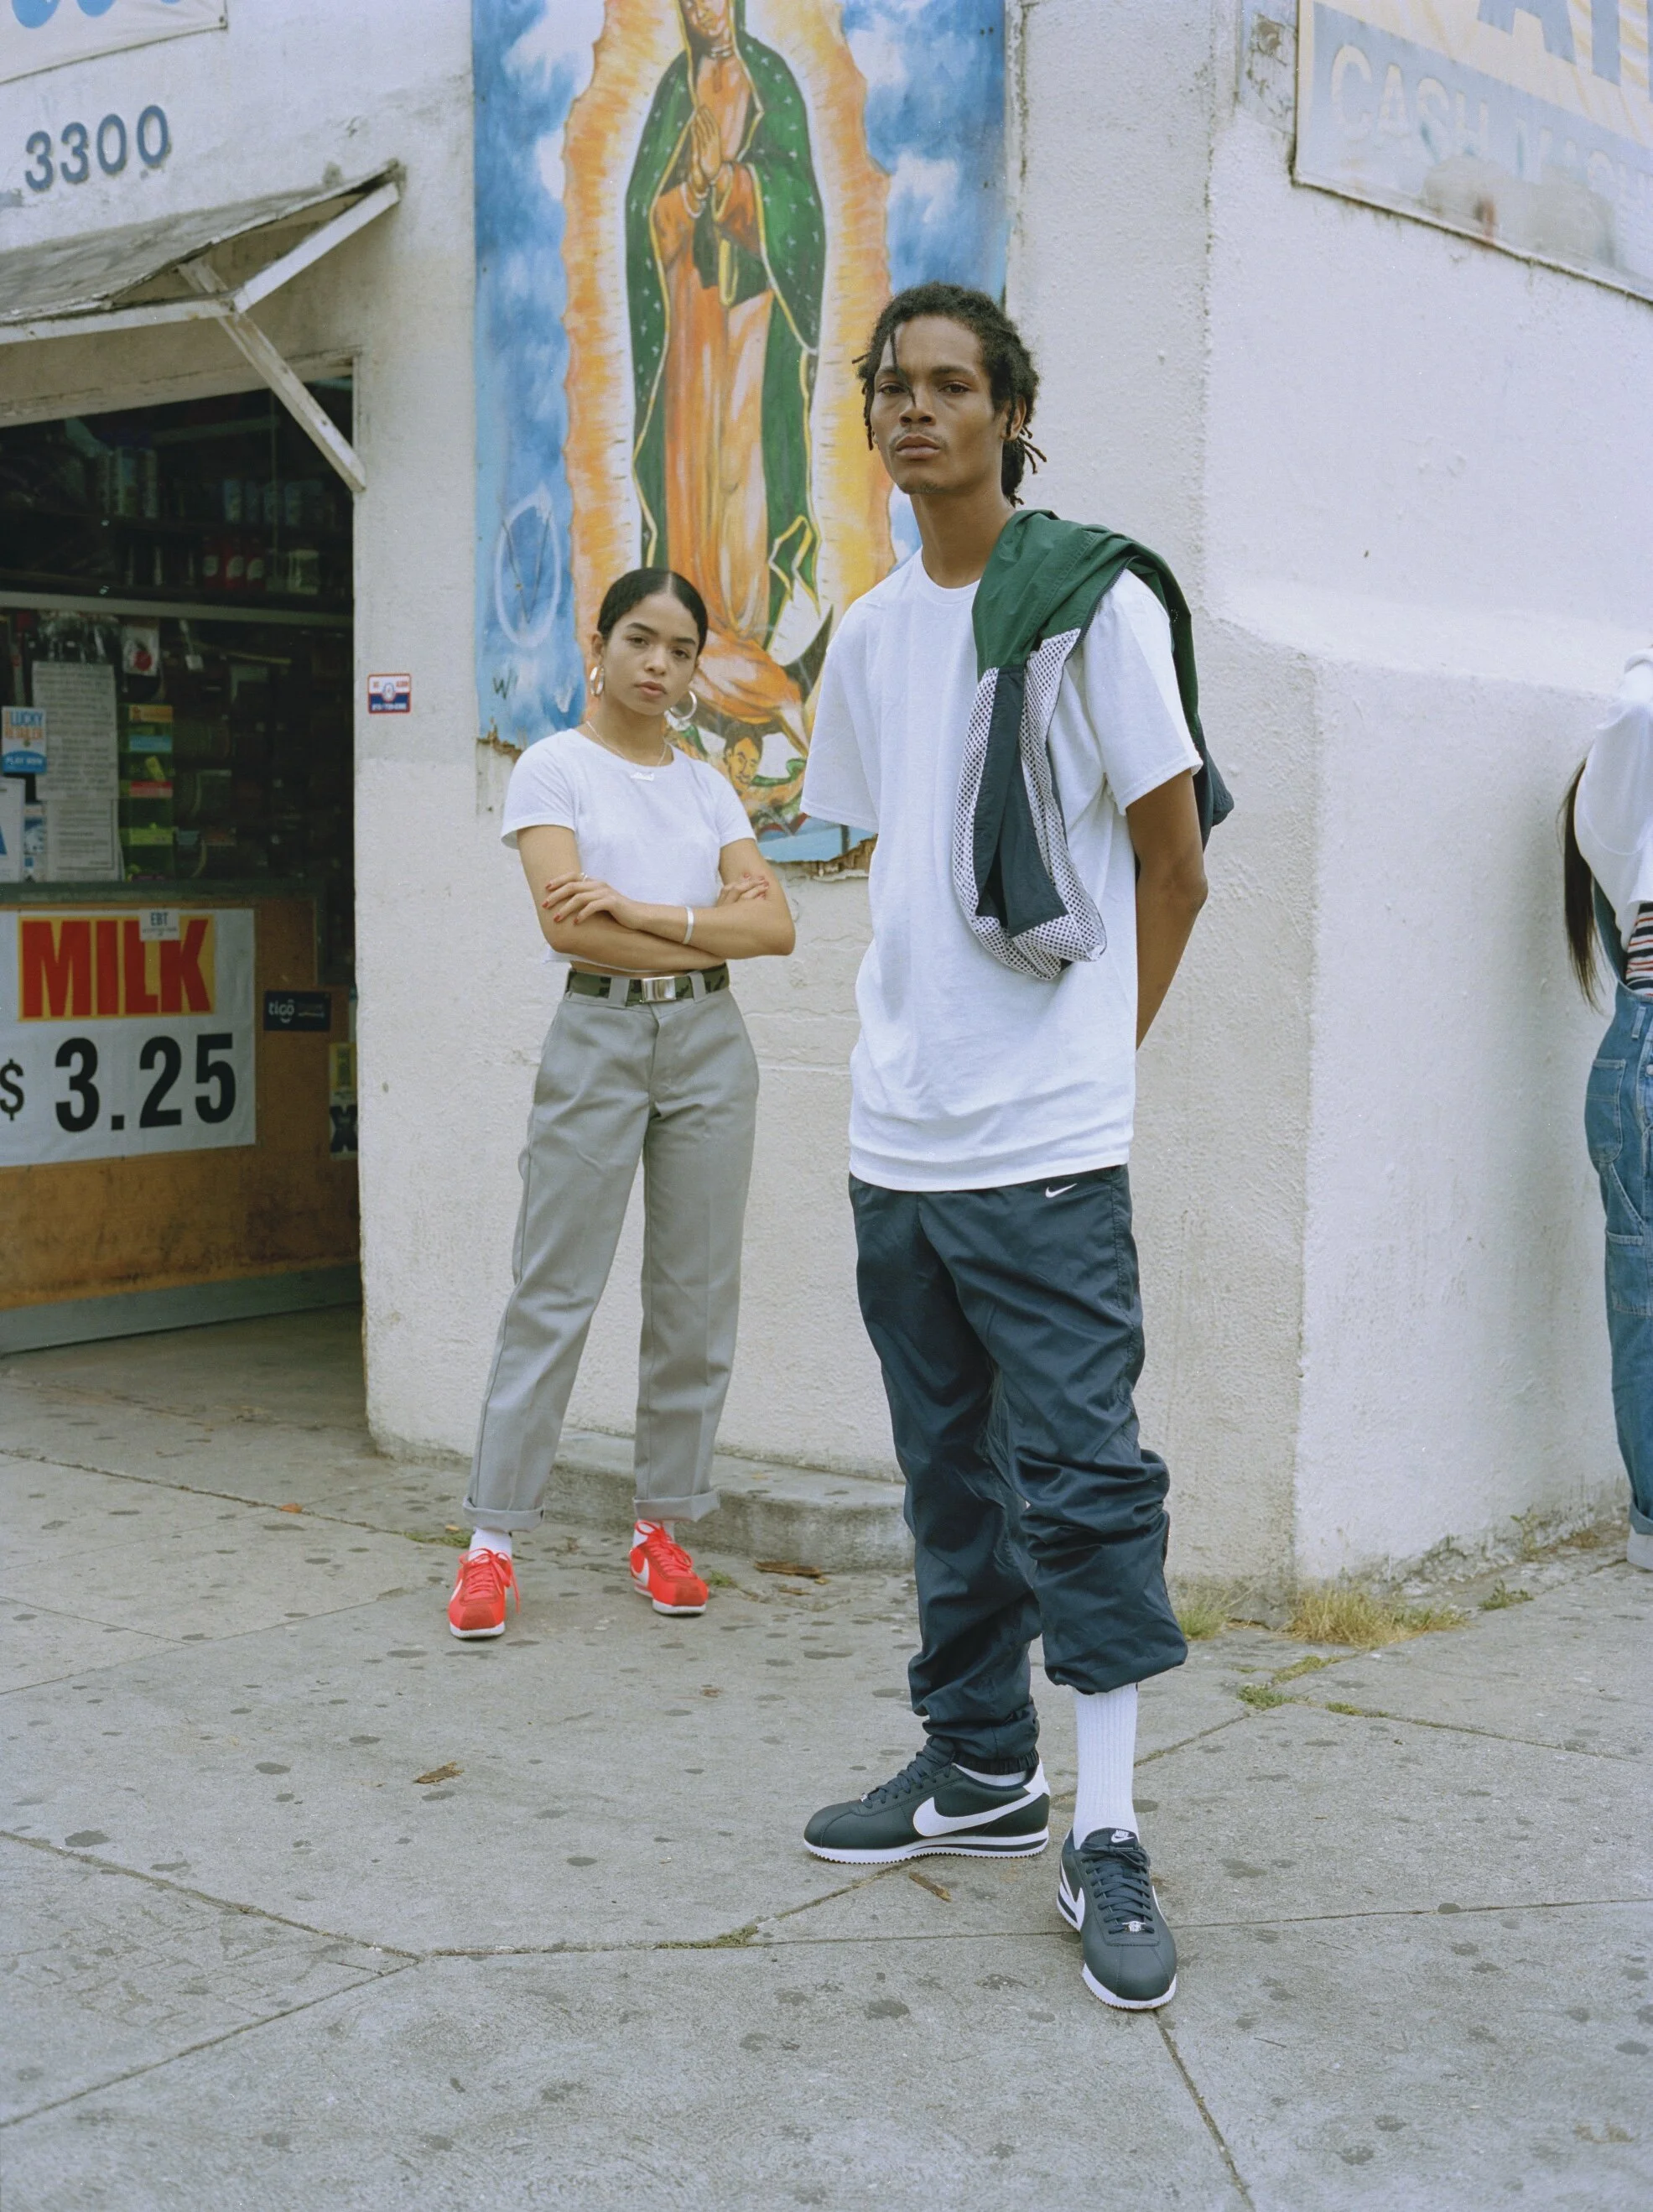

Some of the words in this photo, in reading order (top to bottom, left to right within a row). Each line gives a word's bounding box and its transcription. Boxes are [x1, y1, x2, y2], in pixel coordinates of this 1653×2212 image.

[25, 105, 169, 192] 3300
[151, 912, 168, 927] EBT
[22, 919, 211, 1018] MILK
[0, 1059, 24, 1121] $
[55, 1033, 237, 1132] 3.25
